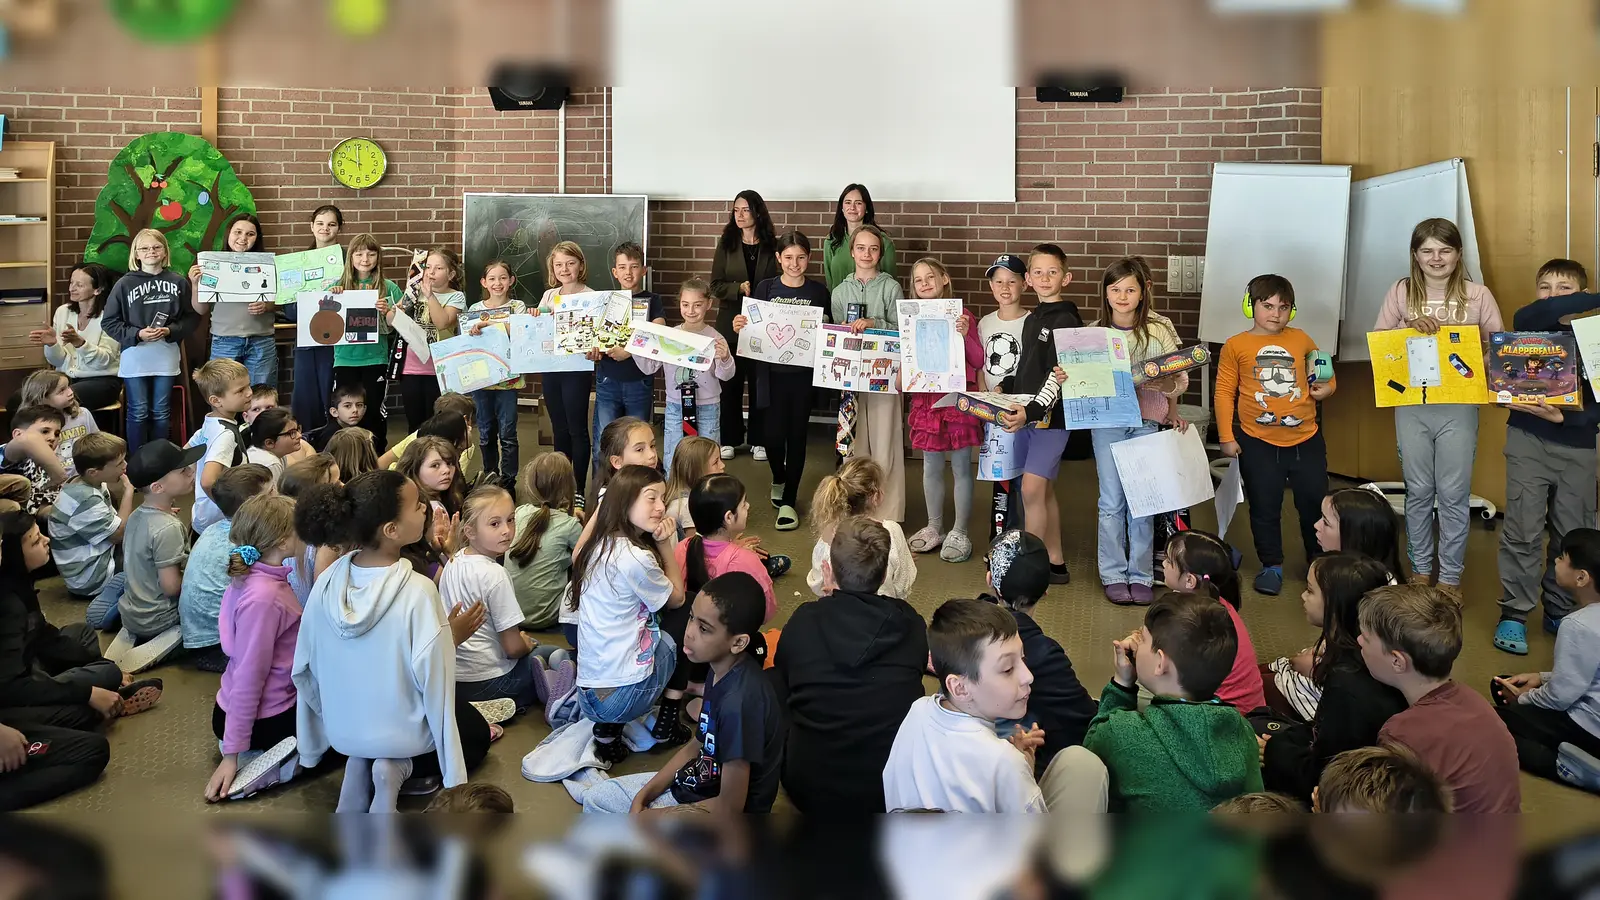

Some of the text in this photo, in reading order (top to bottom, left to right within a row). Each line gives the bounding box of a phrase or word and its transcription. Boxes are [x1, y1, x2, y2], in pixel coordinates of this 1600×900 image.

[370, 151, 376, 159] 2
[336, 159, 343, 167] 9
[373, 159, 379, 167] 3
[339, 168, 346, 176] 8
[348, 174, 353, 182] 7
[355, 176, 361, 184] 6
[364, 174, 371, 182] 5
[127, 279, 181, 308] NEW YOR
[1502, 345, 1562, 356] KLAPPERFALLE
